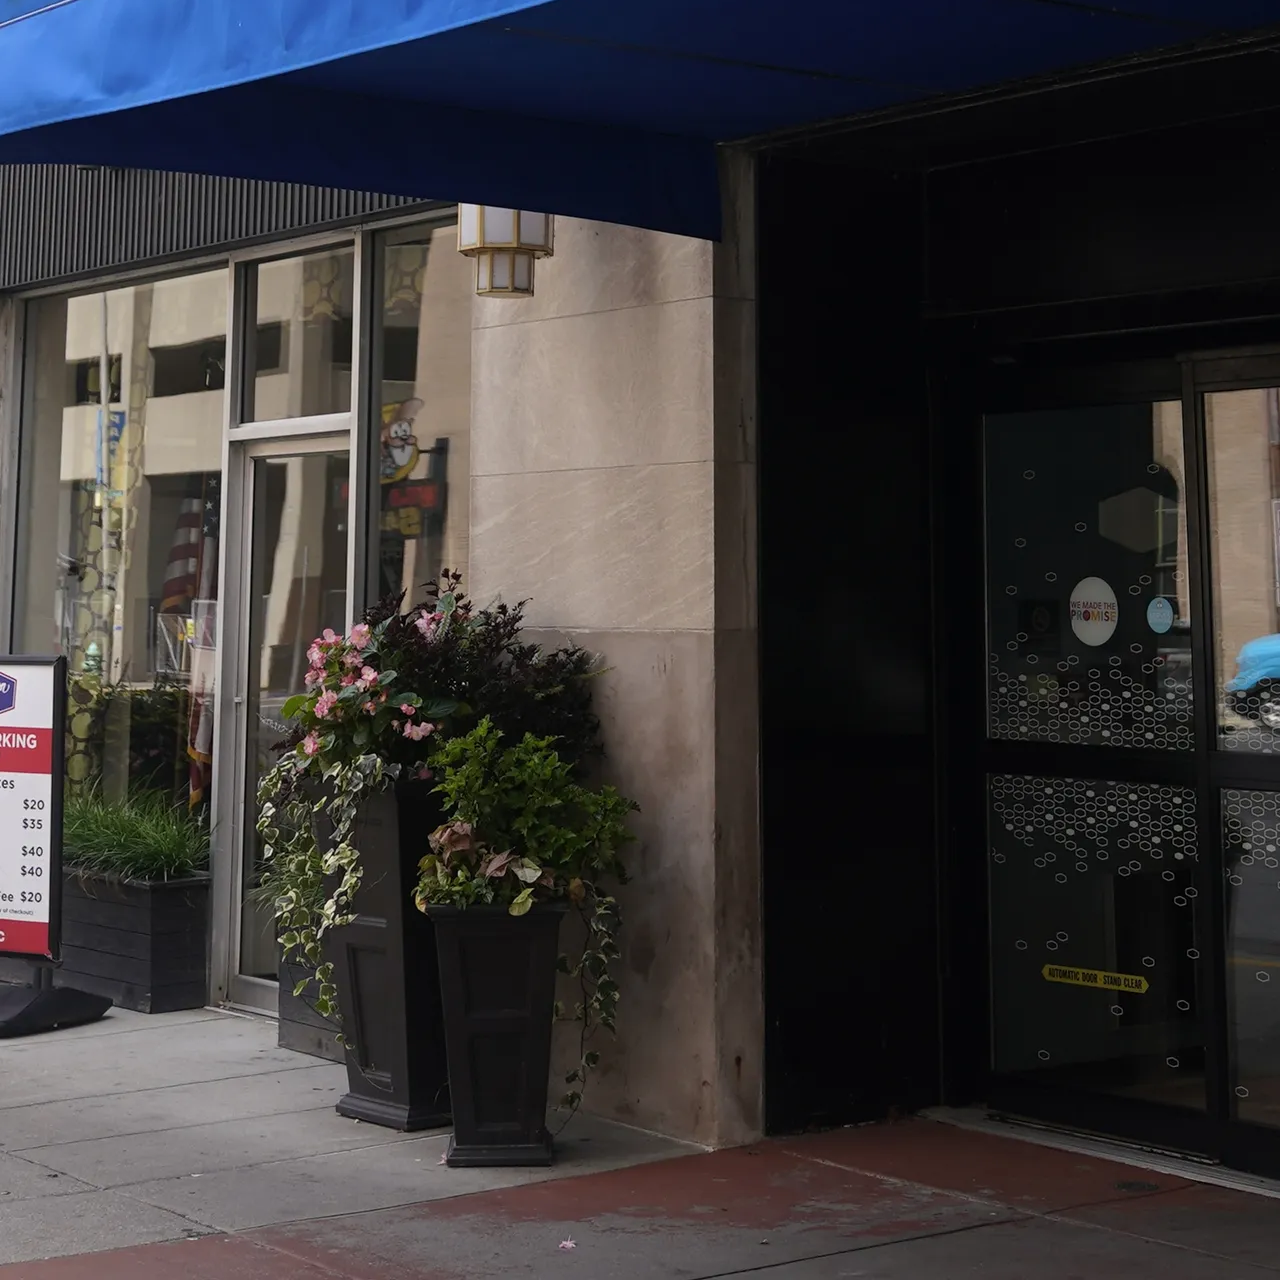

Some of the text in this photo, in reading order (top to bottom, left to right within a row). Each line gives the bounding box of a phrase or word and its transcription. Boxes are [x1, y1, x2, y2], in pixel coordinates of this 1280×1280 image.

[1070, 601, 1116, 610] WE MADE THE
[1070, 609, 1116, 622] PROMISE
[23, 799, 45, 811] $20
[22, 818, 43, 830] $35
[21, 845, 44, 857] $40
[20, 865, 43, 877] $40
[20, 891, 42, 903] $20
[1048, 968, 1143, 989] AUTOMATIC DOOR STAND CLEAR
